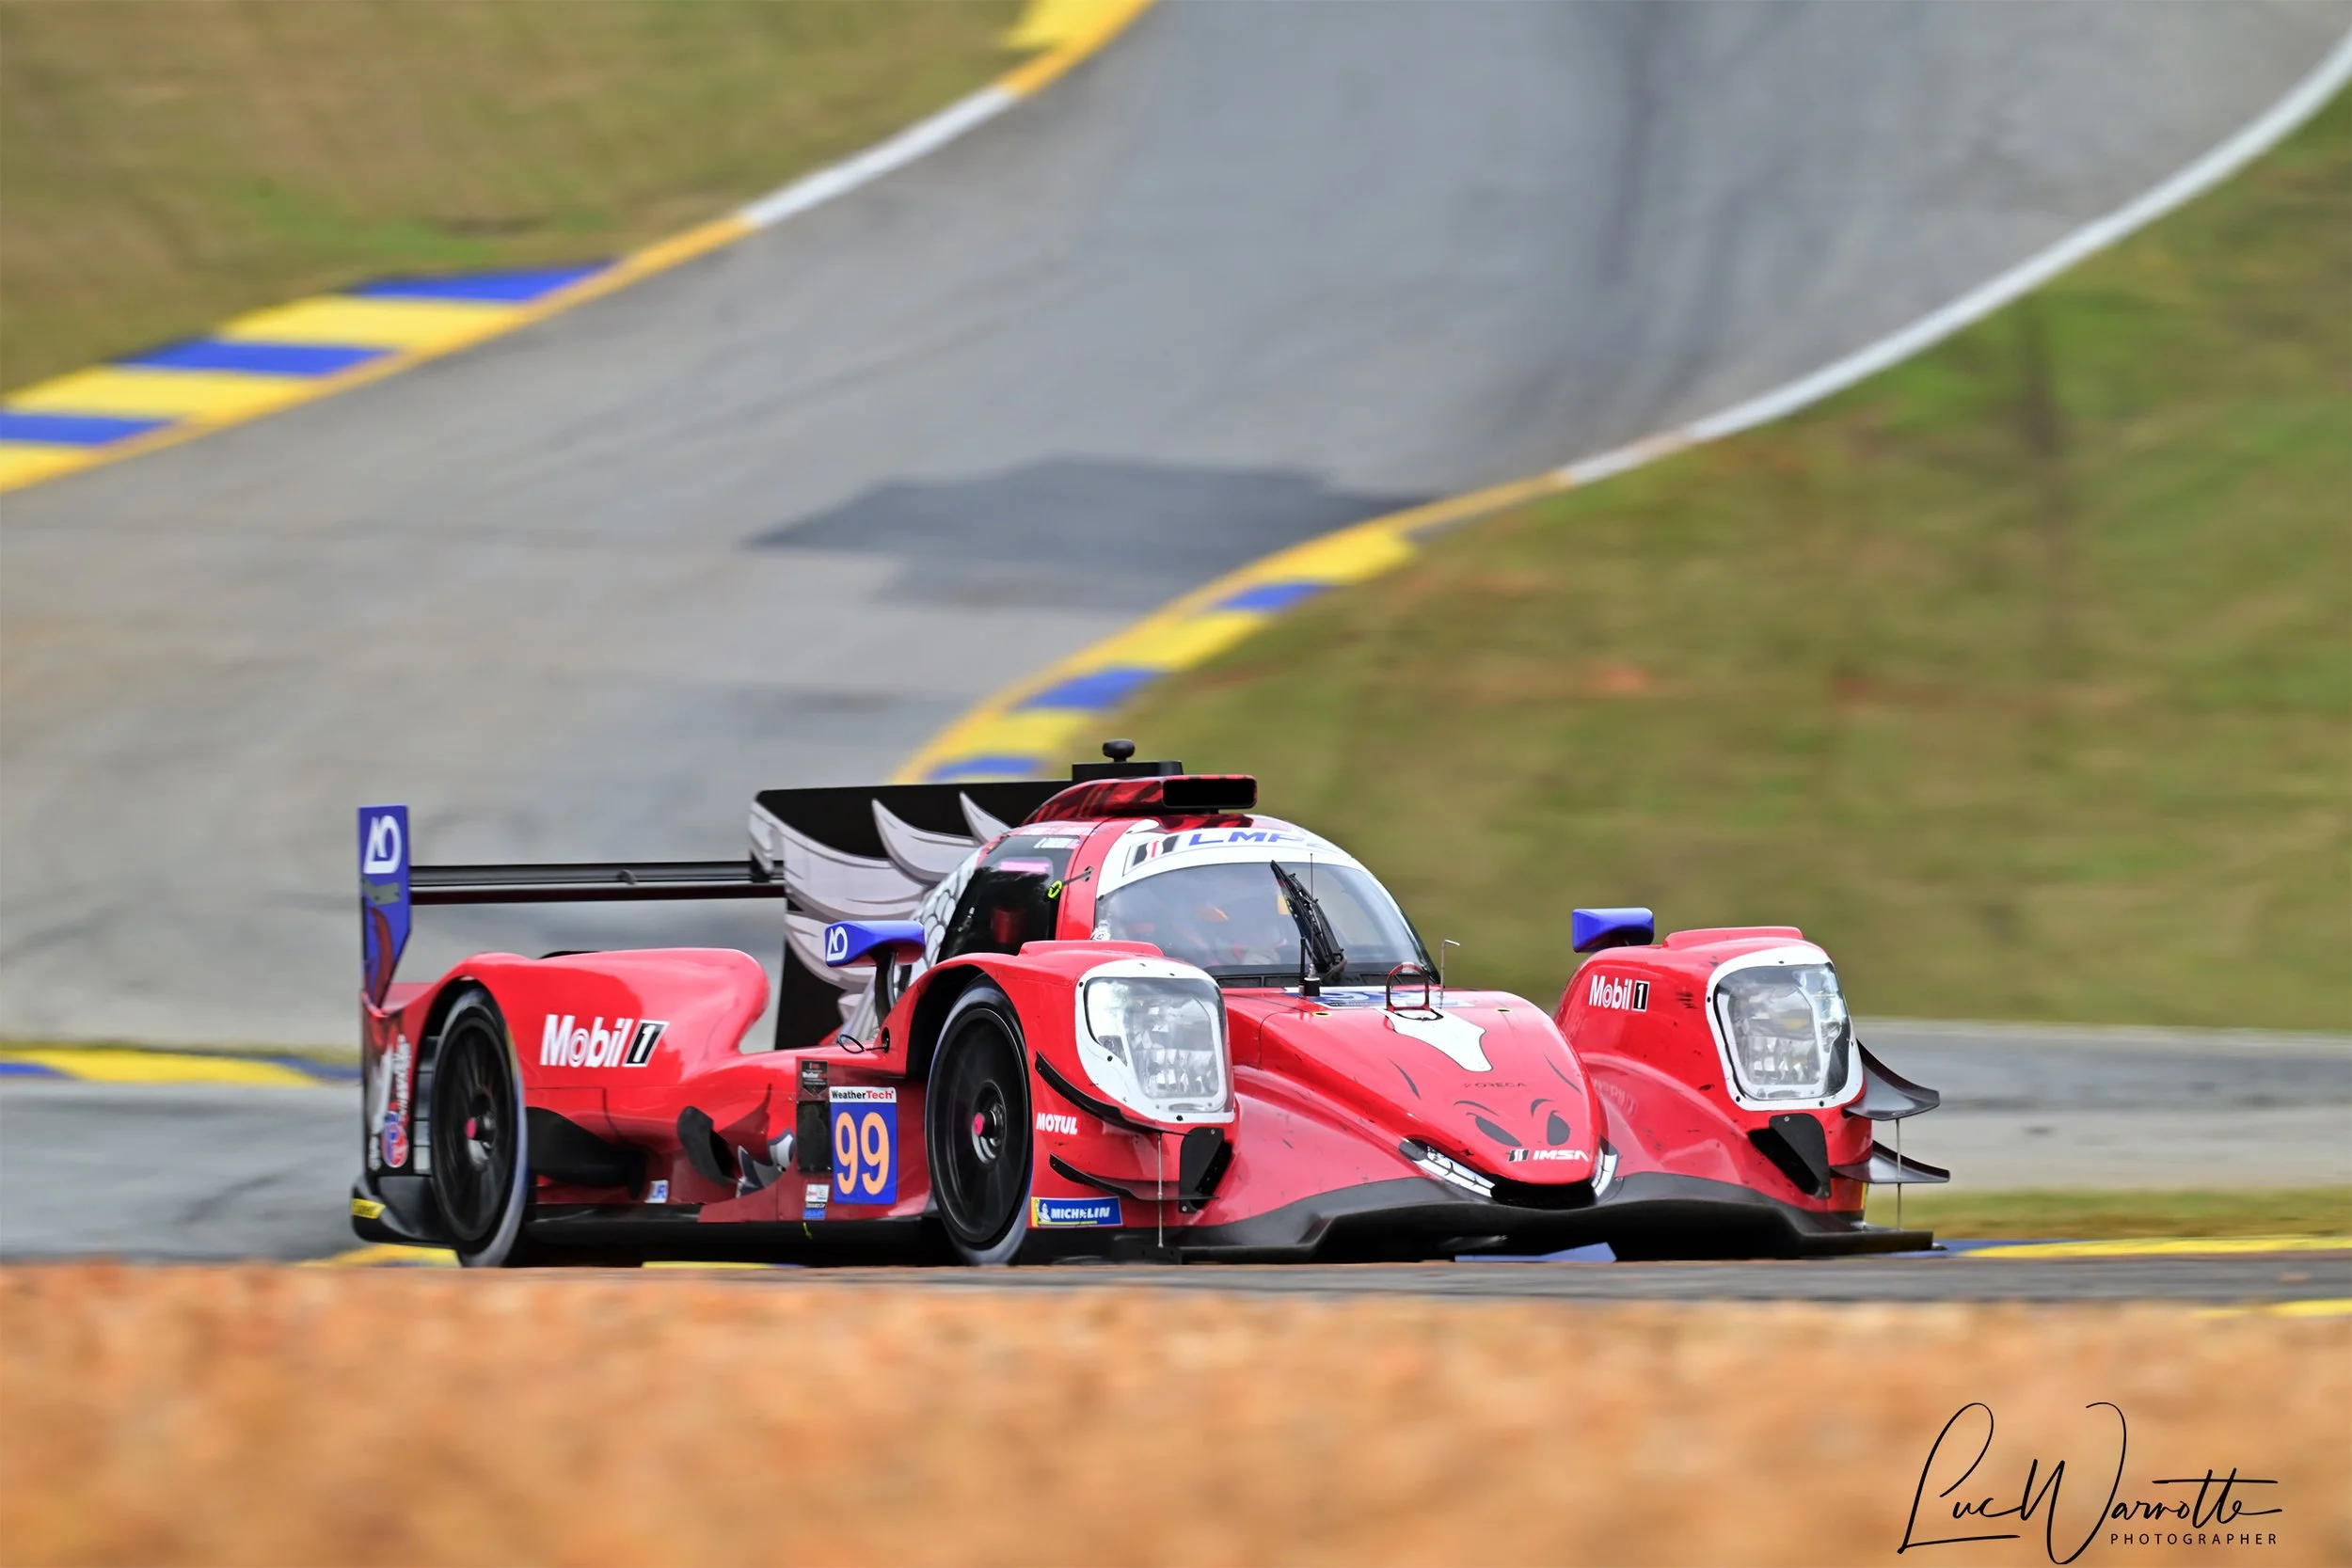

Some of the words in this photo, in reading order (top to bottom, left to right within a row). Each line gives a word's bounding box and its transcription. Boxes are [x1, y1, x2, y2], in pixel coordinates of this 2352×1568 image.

[1588, 974, 1633, 1011] Mobil
[539, 1013, 635, 1069] Mobil
[831, 1089, 894, 1100] WeatherTech
[1036, 1112, 1078, 1135] MOTUL
[834, 1111, 890, 1196] 99
[1532, 1148, 1590, 1163] IMSA
[1050, 1206, 1111, 1220] MICHELIN
